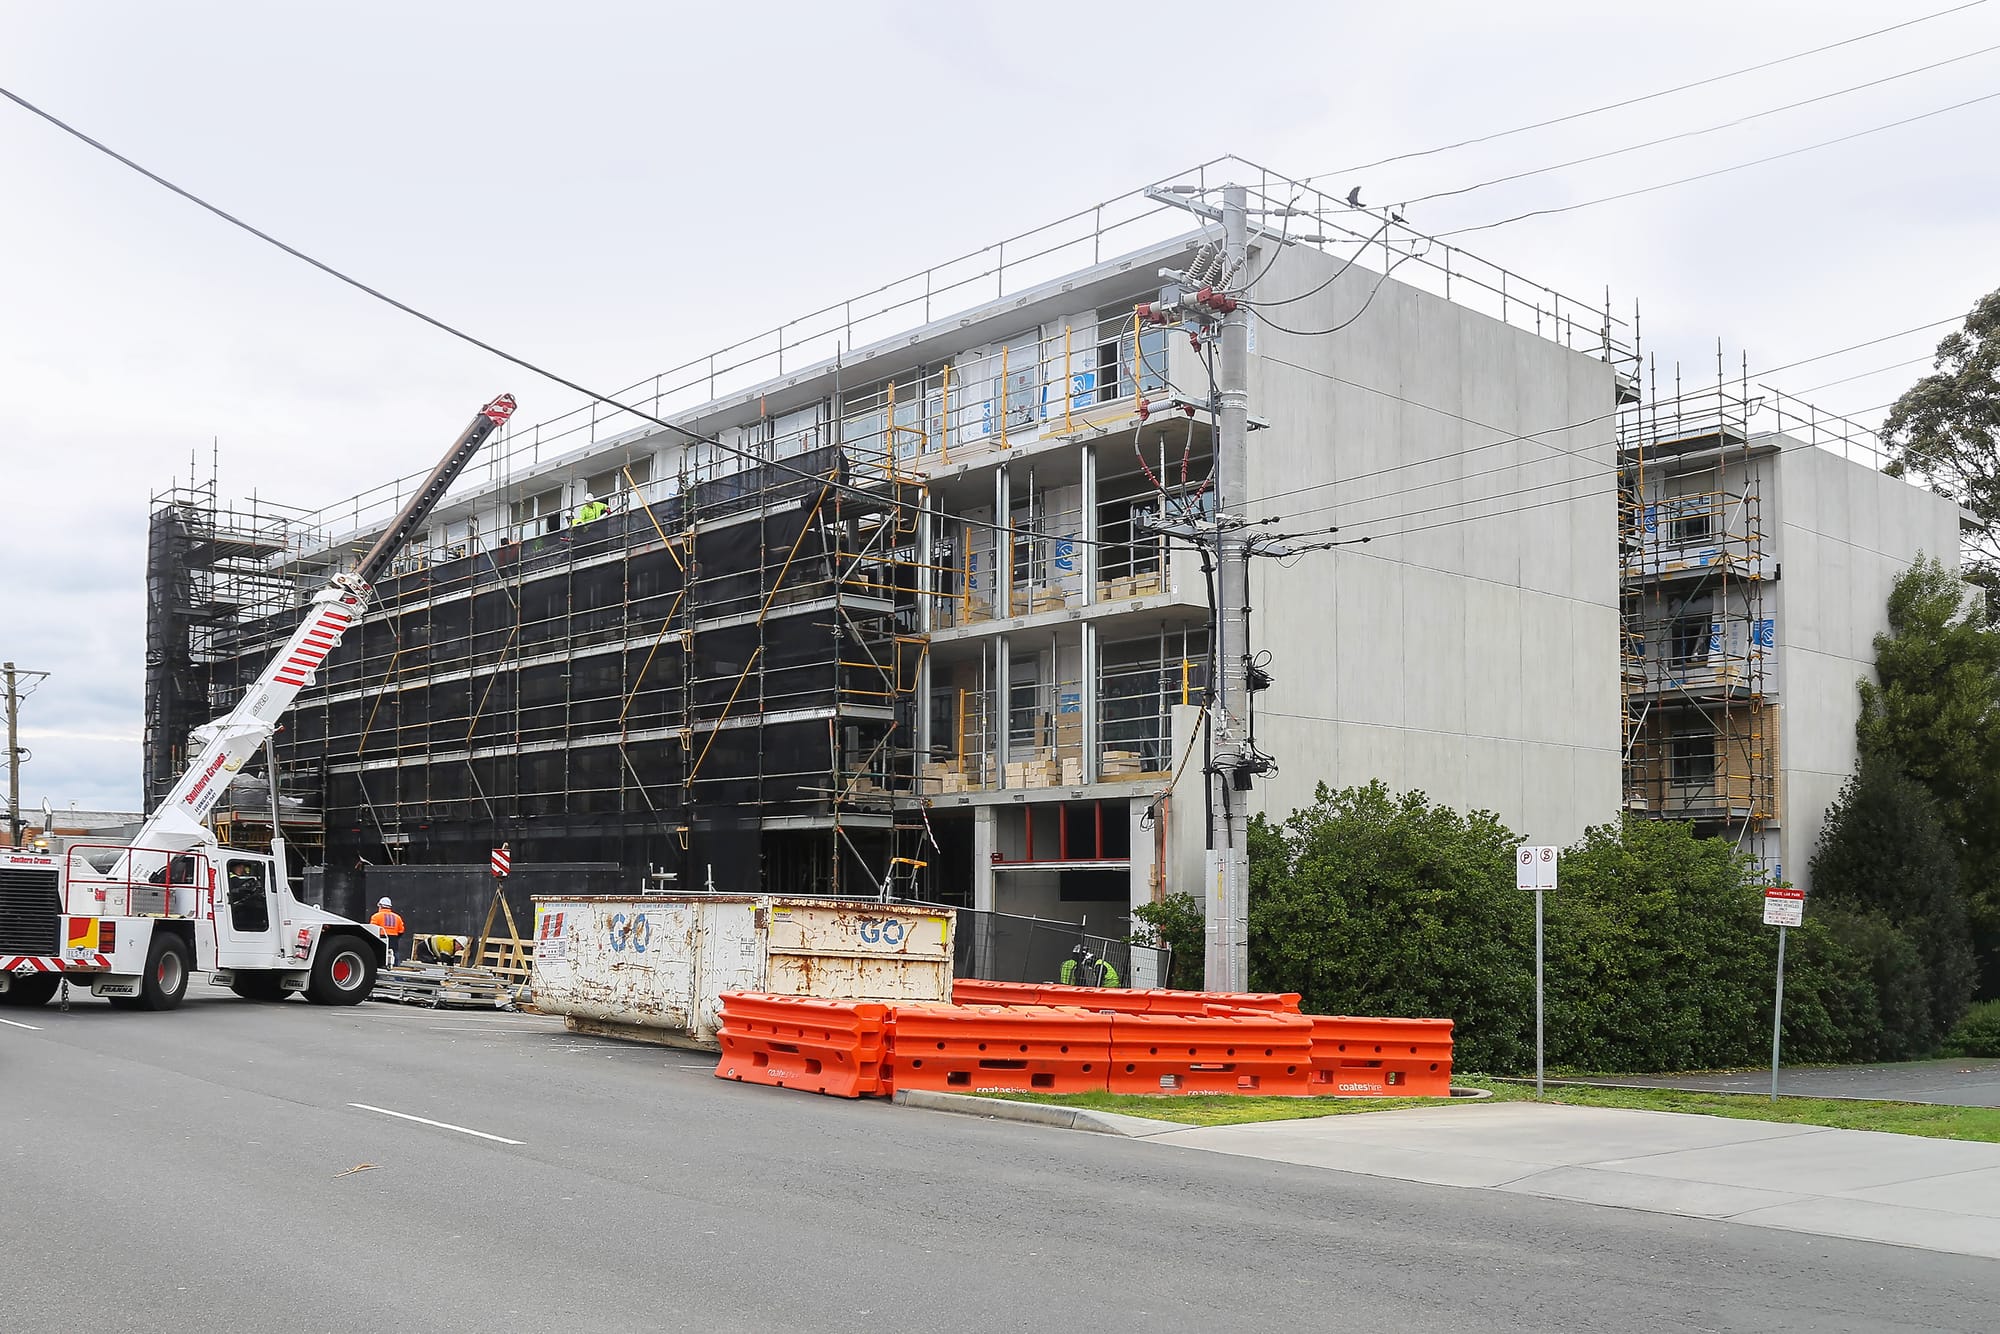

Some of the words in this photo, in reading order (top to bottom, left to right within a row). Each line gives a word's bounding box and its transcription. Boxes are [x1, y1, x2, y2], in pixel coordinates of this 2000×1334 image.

[185, 773, 210, 805] Southern
[206, 752, 227, 778] Cranes
[10, 856, 33, 864] Southern
[34, 857, 52, 865] Cranes
[610, 913, 650, 953] GO
[860, 920, 904, 945] GO
